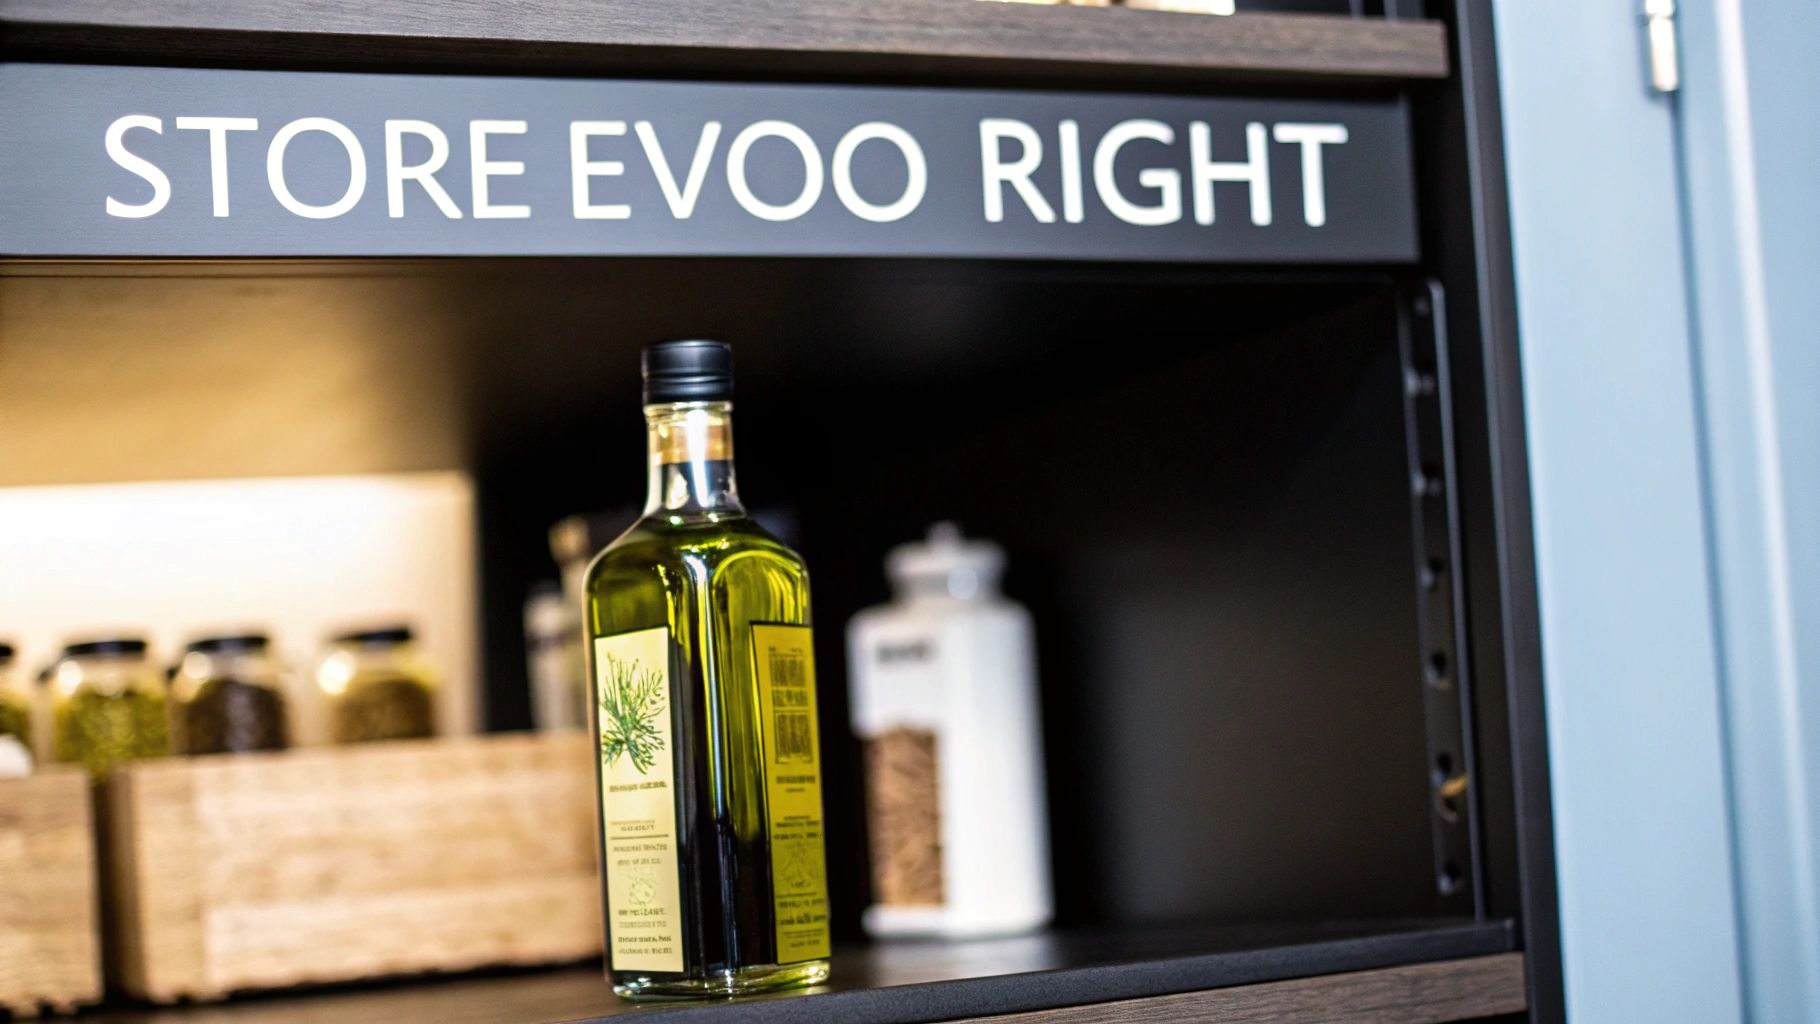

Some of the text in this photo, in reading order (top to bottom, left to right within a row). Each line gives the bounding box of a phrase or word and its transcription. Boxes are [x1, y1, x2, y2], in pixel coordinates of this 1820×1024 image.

[105, 114, 1348, 227] STORE EVOO RIGHT
